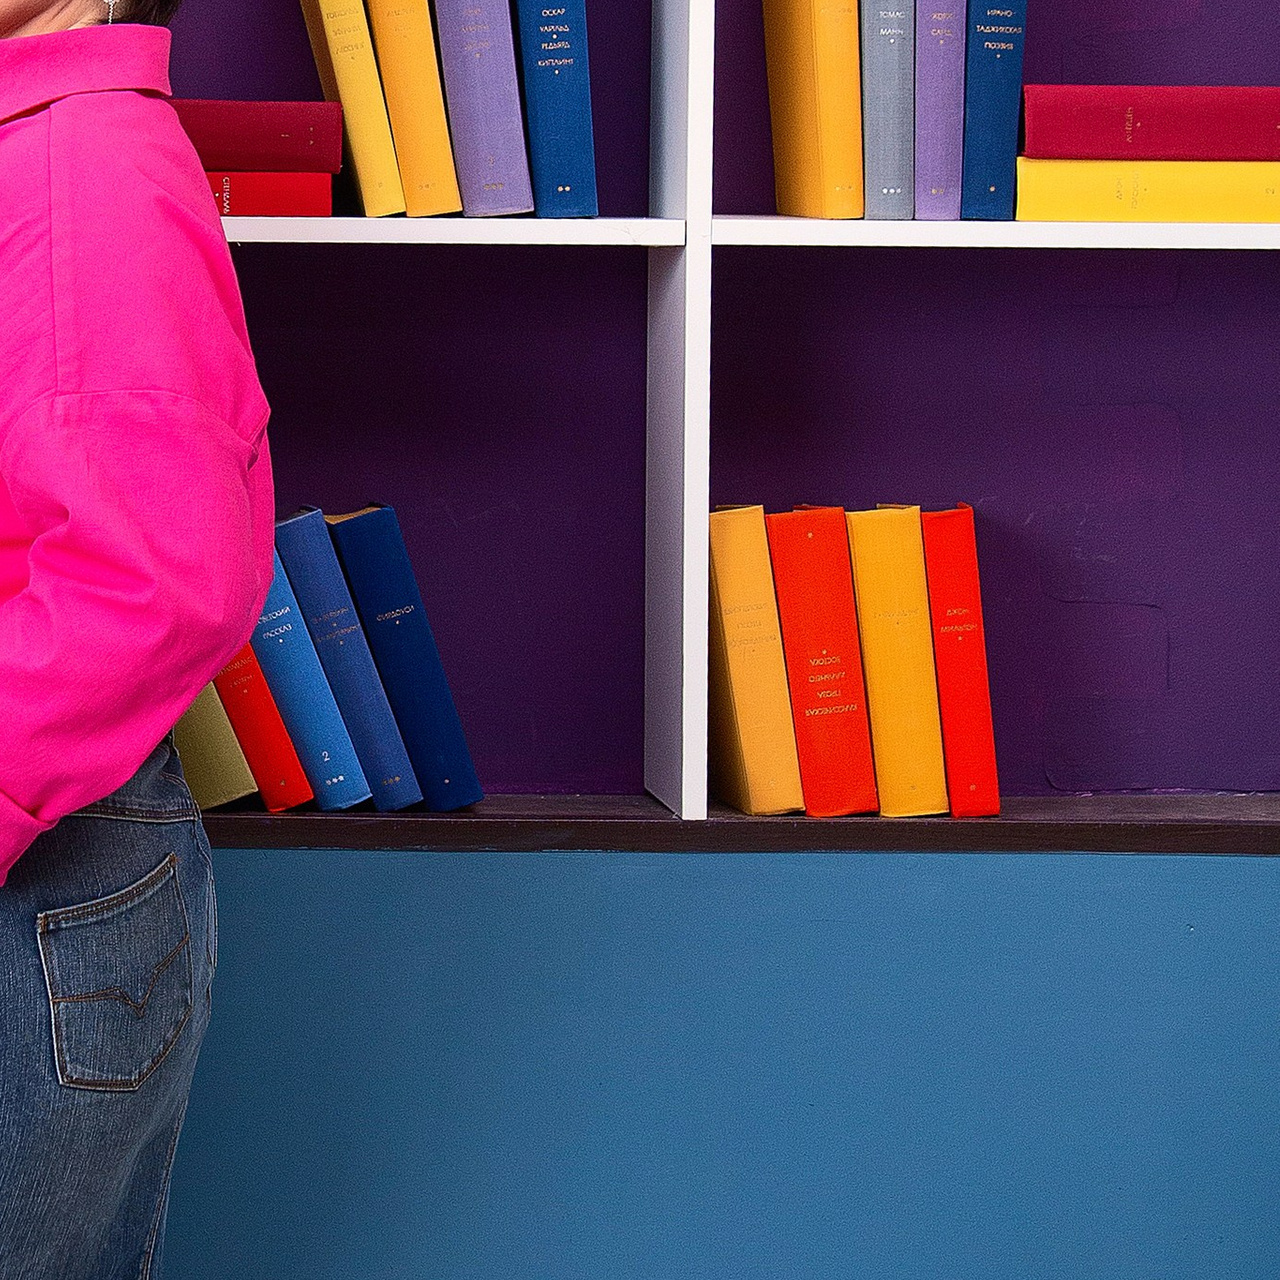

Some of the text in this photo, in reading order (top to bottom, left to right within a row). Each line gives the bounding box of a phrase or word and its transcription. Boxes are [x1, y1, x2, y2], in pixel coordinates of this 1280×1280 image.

[541, 7, 566, 17] ОСКАР
[878, 10, 905, 20] ТОМАС
[538, 22, 570, 33] УАЙЛЬД
[879, 27, 905, 37] МАНН
[975, 25, 1023, 34] ТАДЖИКСКАЯ
[540, 40, 571, 50] РЕДЬЯРД
[984, 41, 1014, 51] ПОЭЗИЯ
[537, 57, 574, 67] КИПЛИНГ
[221, 175, 231, 215] СТЕНДАЛЬ
[375, 604, 415, 622] ФИРДОУСИ
[262, 624, 292, 640] РАССКАЗ
[809, 656, 841, 666] ВОСТОКА
[808, 671, 846, 683] ДАЛЬНЕГО
[816, 689, 842, 698] ПРОЗА
[804, 704, 858, 717] КЛАССИЧЕСКАЯ
[321, 751, 331, 762] 2
